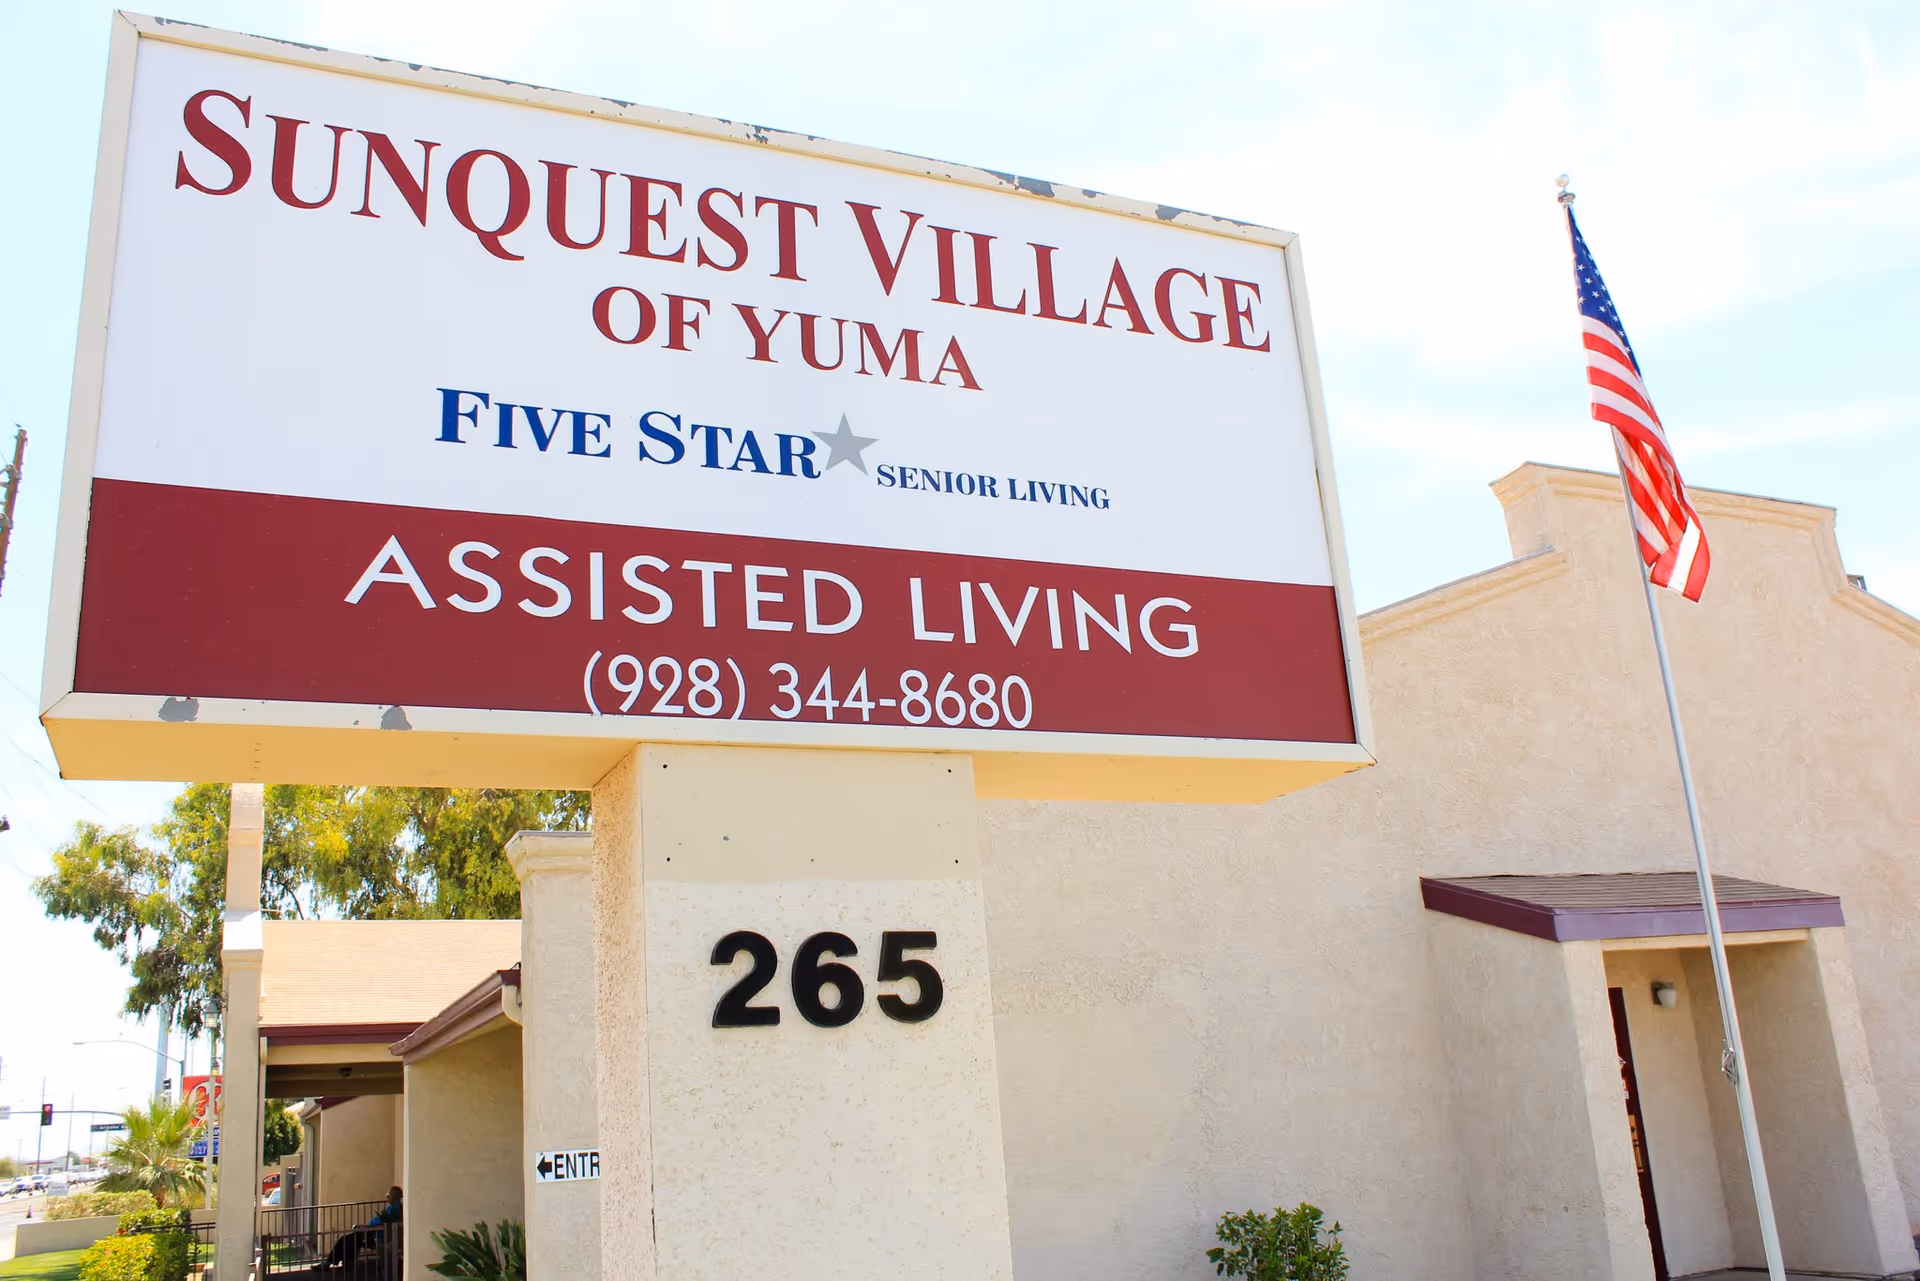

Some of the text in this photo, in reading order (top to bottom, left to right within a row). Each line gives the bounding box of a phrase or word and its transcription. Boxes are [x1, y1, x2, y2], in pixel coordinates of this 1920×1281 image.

[175, 89, 1271, 353] SUNQUEST VILLAGE
[591, 286, 984, 391] OF YUMA
[434, 387, 822, 480] FIVE STAR
[876, 463, 1111, 510] SENIOR LIVING
[343, 534, 1199, 658] ASSISTED LIVING
[583, 650, 1033, 729] (928) 344-8680
[711, 930, 944, 1029] 265
[554, 1151, 600, 1180] ENTR
